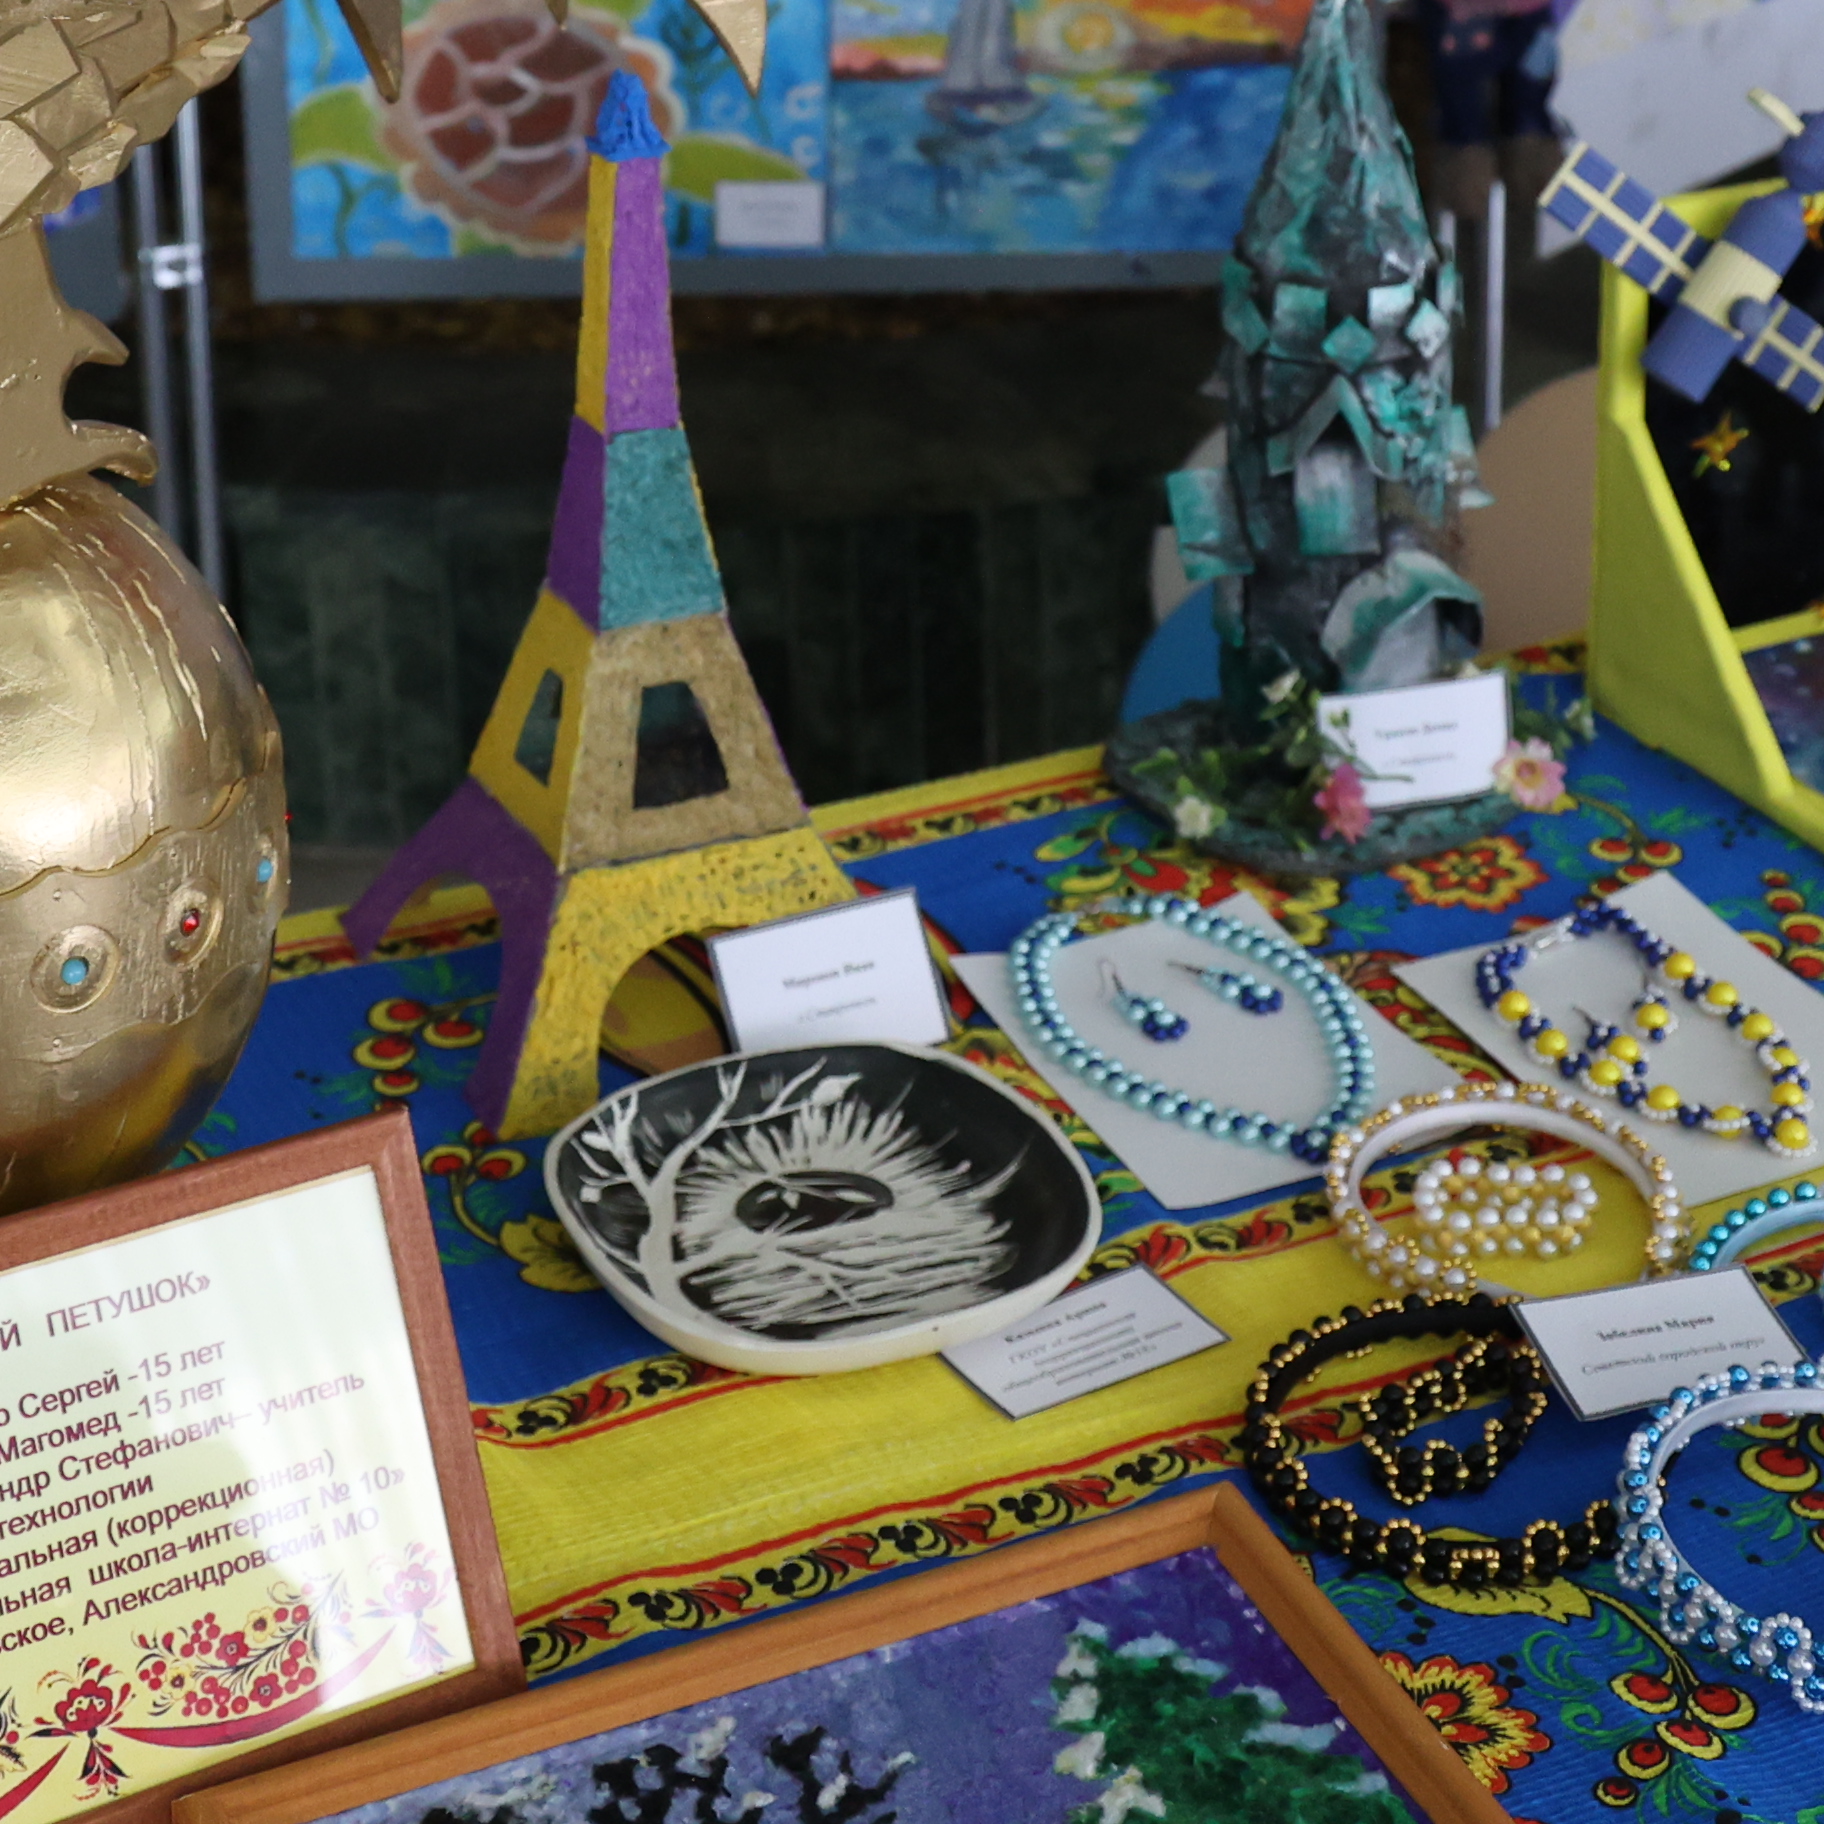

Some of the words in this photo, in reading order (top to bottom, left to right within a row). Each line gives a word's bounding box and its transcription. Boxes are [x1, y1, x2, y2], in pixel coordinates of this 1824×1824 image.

[45, 1271, 212, 1338] ПЕТУШОК»
[18, 1367, 121, 1419] Сергей
[179, 1340, 227, 1372] лет
[179, 1377, 227, 1409] лет
[257, 1372, 366, 1426] учитель
[87, 1495, 313, 1587] школа-интернат
[319, 1480, 351, 1507] №
[358, 1464, 406, 1495] 10»
[105, 1449, 336, 1548] (коррекционная)
[81, 1525, 327, 1627] Александровский
[332, 1505, 381, 1542] МО
